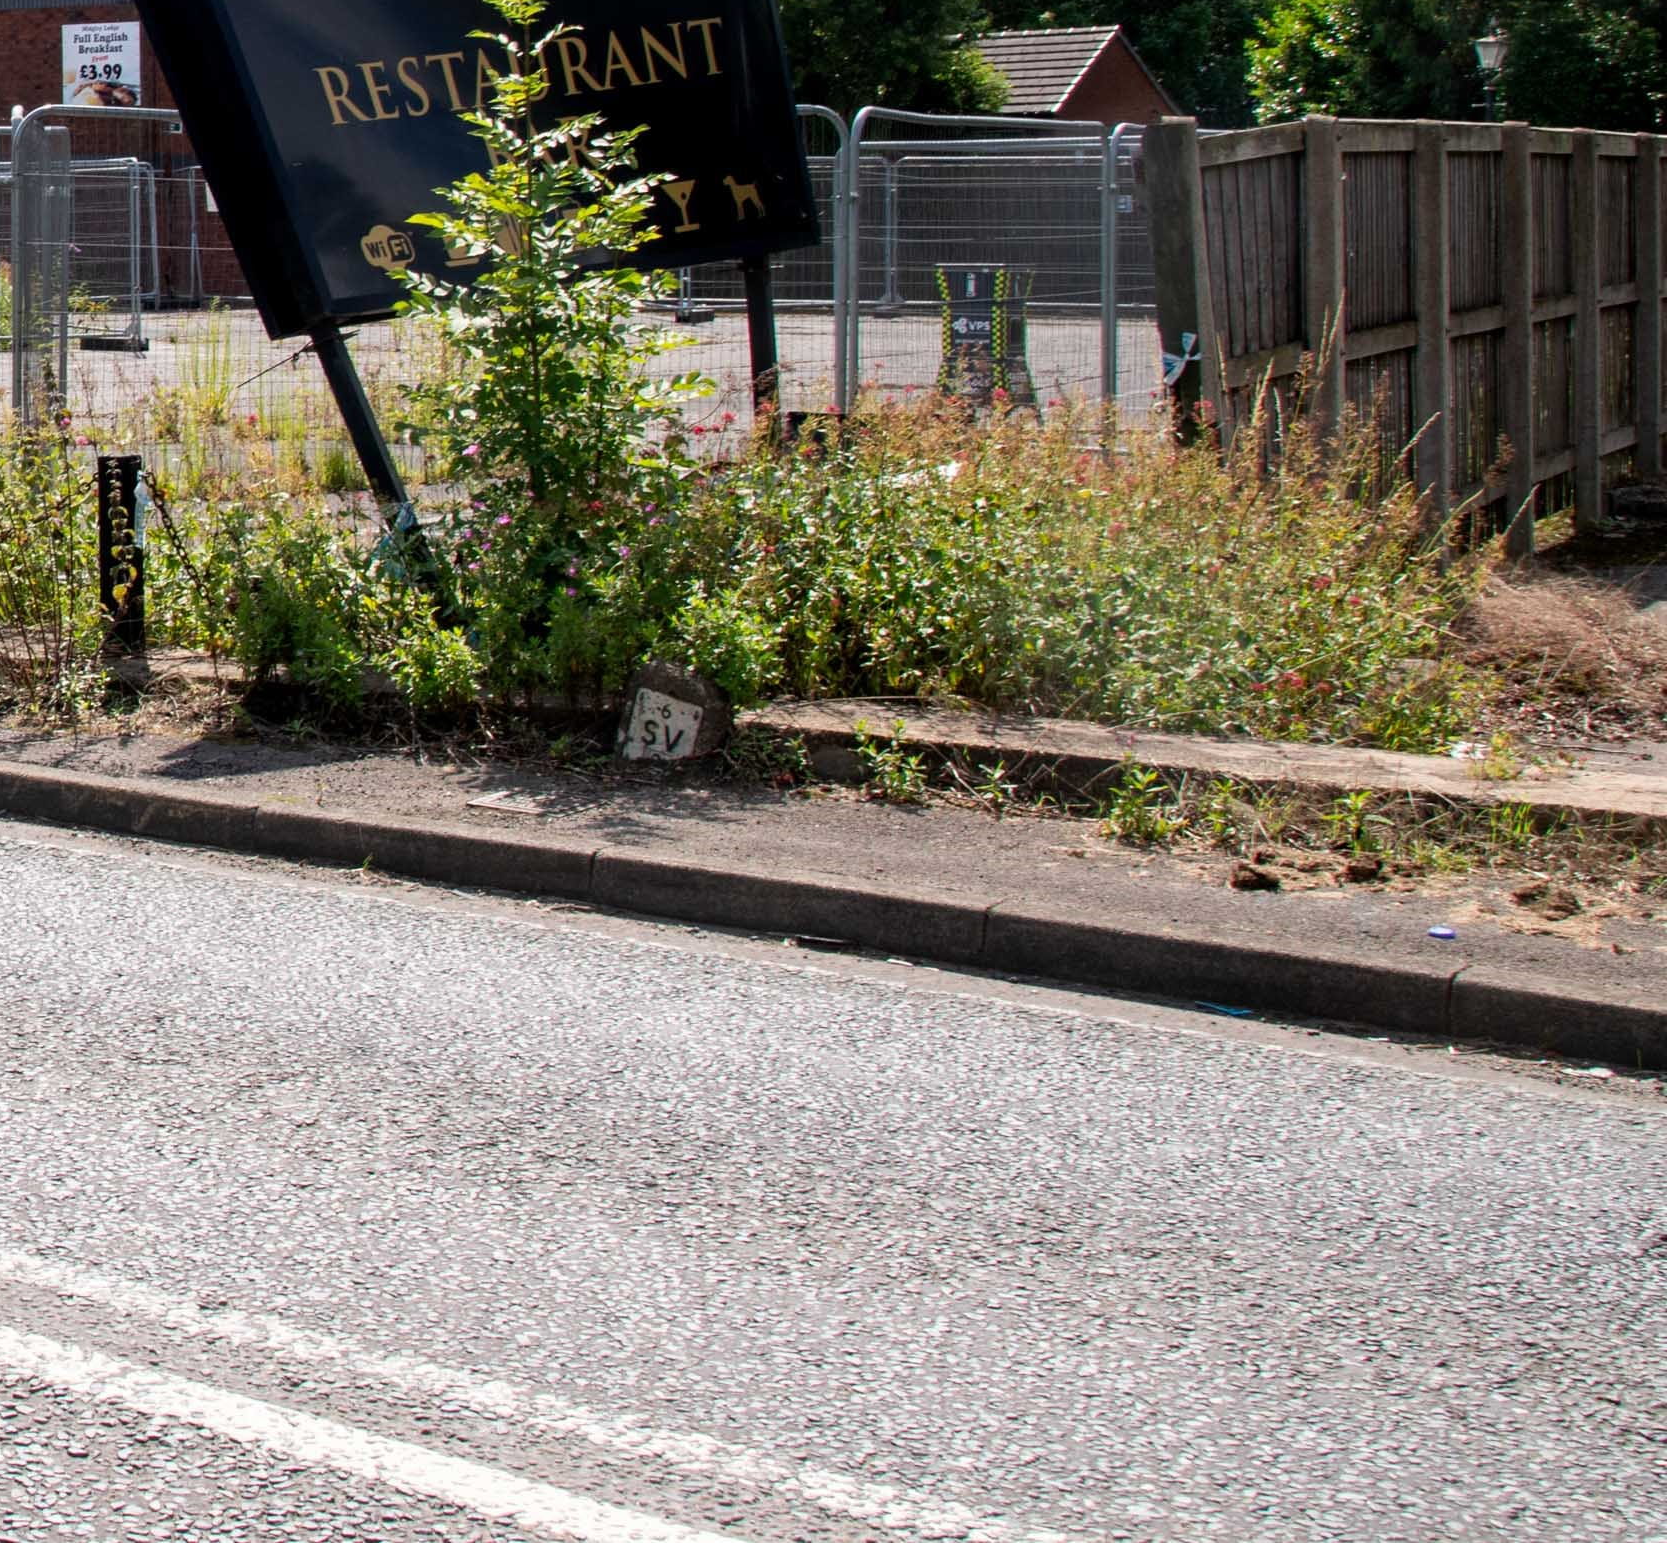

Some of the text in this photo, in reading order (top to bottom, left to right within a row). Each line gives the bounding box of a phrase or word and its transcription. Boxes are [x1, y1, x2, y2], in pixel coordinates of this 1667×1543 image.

[73, 32, 128, 44] Full English
[78, 44, 123, 54] Breakfast
[80, 63, 122, 80] £3.99
[313, 17, 722, 125] RESTAURANT
[968, 320, 990, 331] VPS
[662, 704, 671, 719] 6
[641, 720, 684, 752] SV
